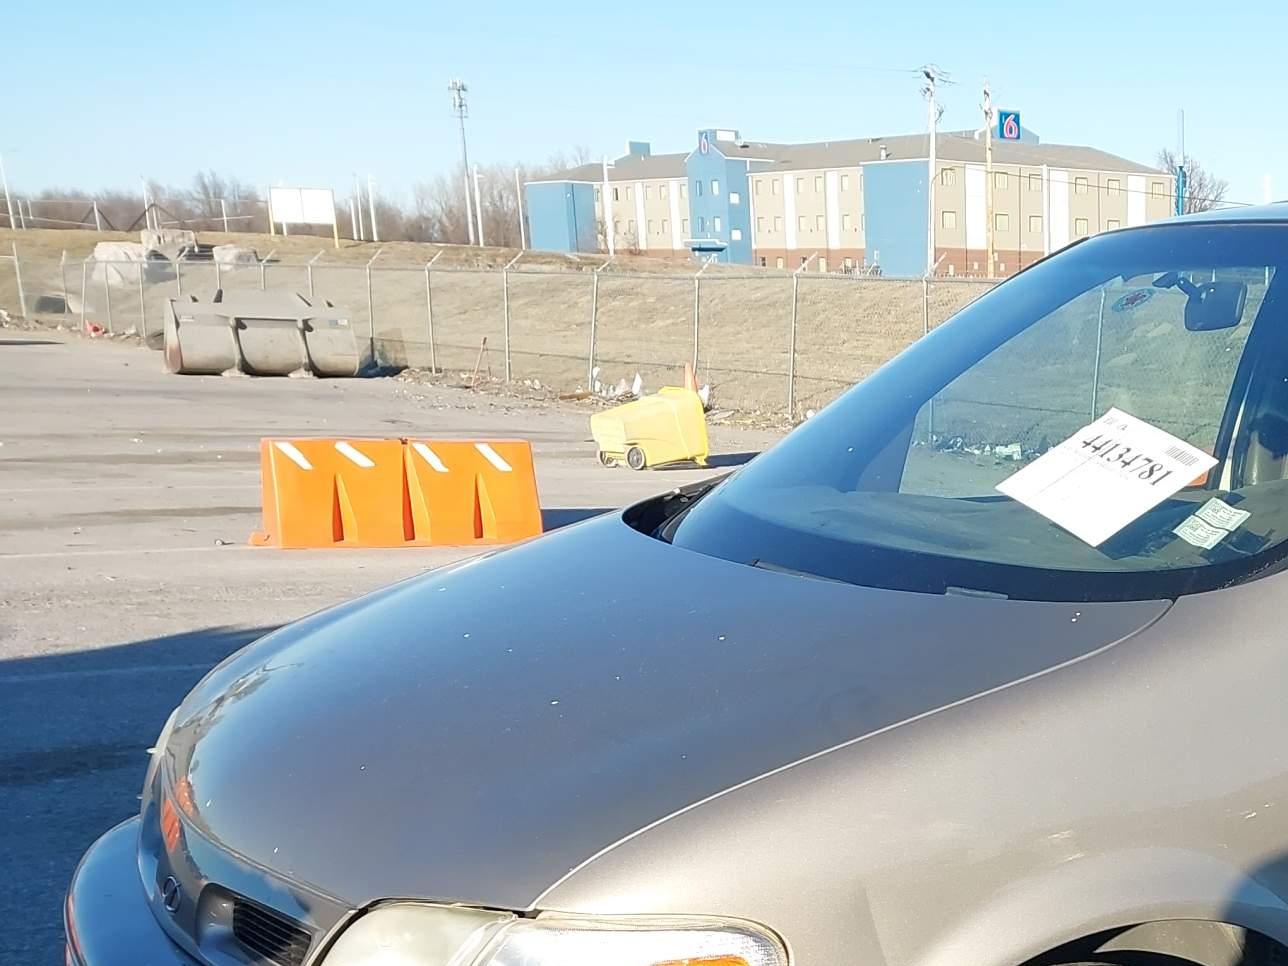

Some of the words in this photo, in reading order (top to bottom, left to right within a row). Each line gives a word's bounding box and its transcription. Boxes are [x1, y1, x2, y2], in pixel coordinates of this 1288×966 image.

[1003, 113, 1019, 139] 6
[701, 132, 708, 154] 6
[1082, 434, 1173, 486] 44134781
